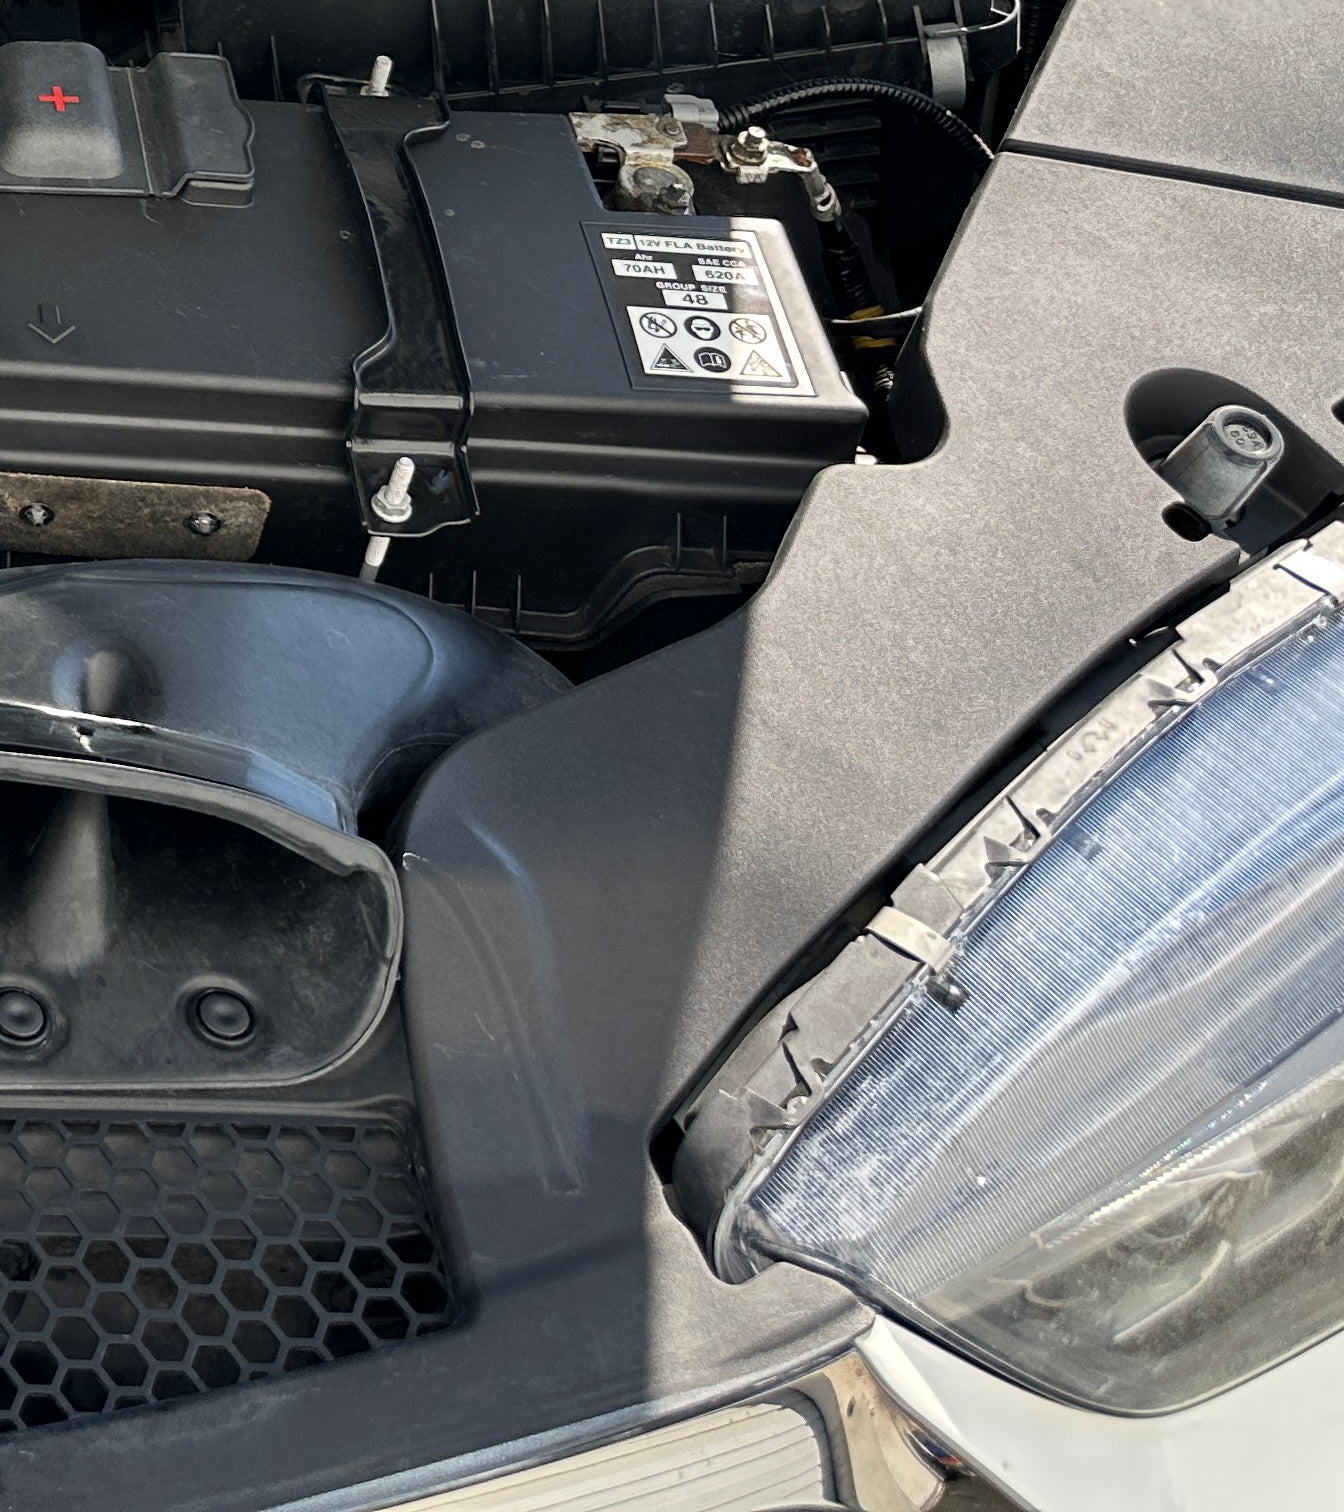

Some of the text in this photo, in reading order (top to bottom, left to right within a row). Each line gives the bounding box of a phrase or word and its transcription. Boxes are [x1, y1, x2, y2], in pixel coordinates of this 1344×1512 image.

[640, 238, 661, 248] 12V
[665, 240, 694, 250] FLA
[696, 242, 746, 255] Battery
[697, 257, 747, 268] SAE CCA
[623, 263, 666, 275] 70AH
[705, 269, 746, 281] 620A
[655, 281, 728, 294] GROUP SIZE
[682, 293, 709, 306] 48
